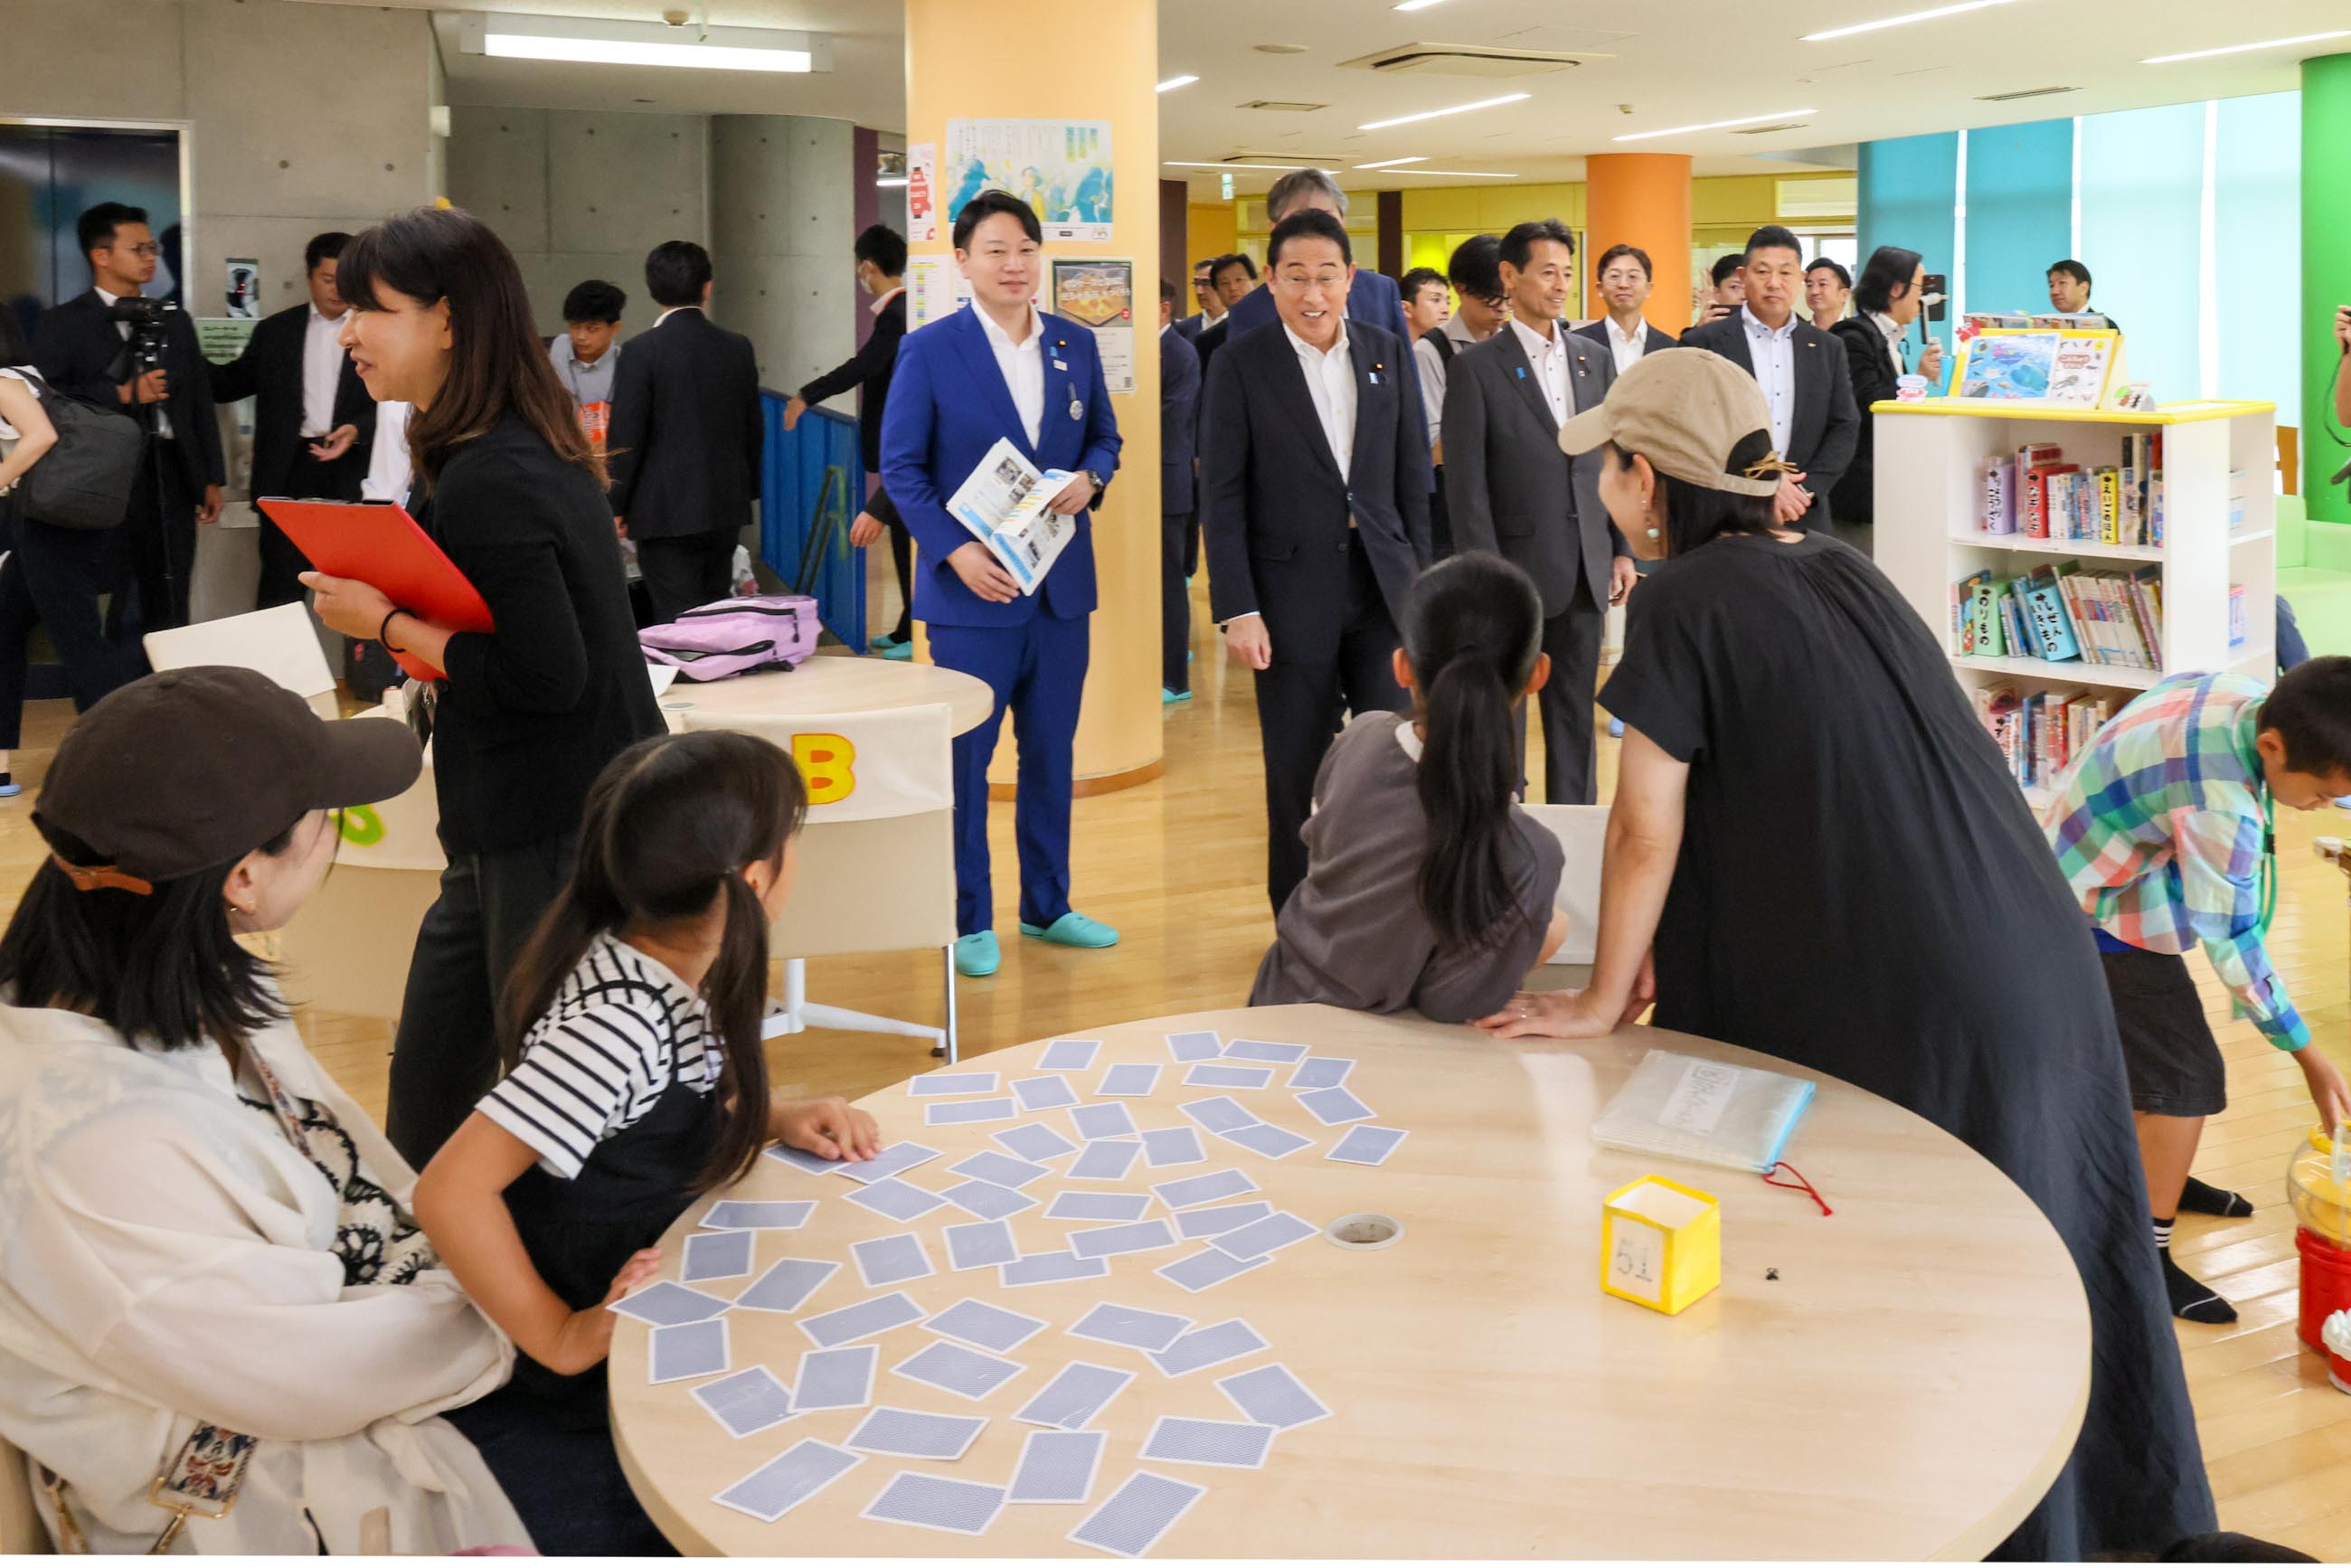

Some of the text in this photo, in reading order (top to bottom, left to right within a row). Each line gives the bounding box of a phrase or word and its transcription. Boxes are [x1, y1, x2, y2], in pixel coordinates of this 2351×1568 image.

[1978, 596, 1989, 646] のりもの
[2031, 604, 2058, 652] いきもの
[2044, 601, 2063, 638] しぜん
[790, 732, 856, 805] B
